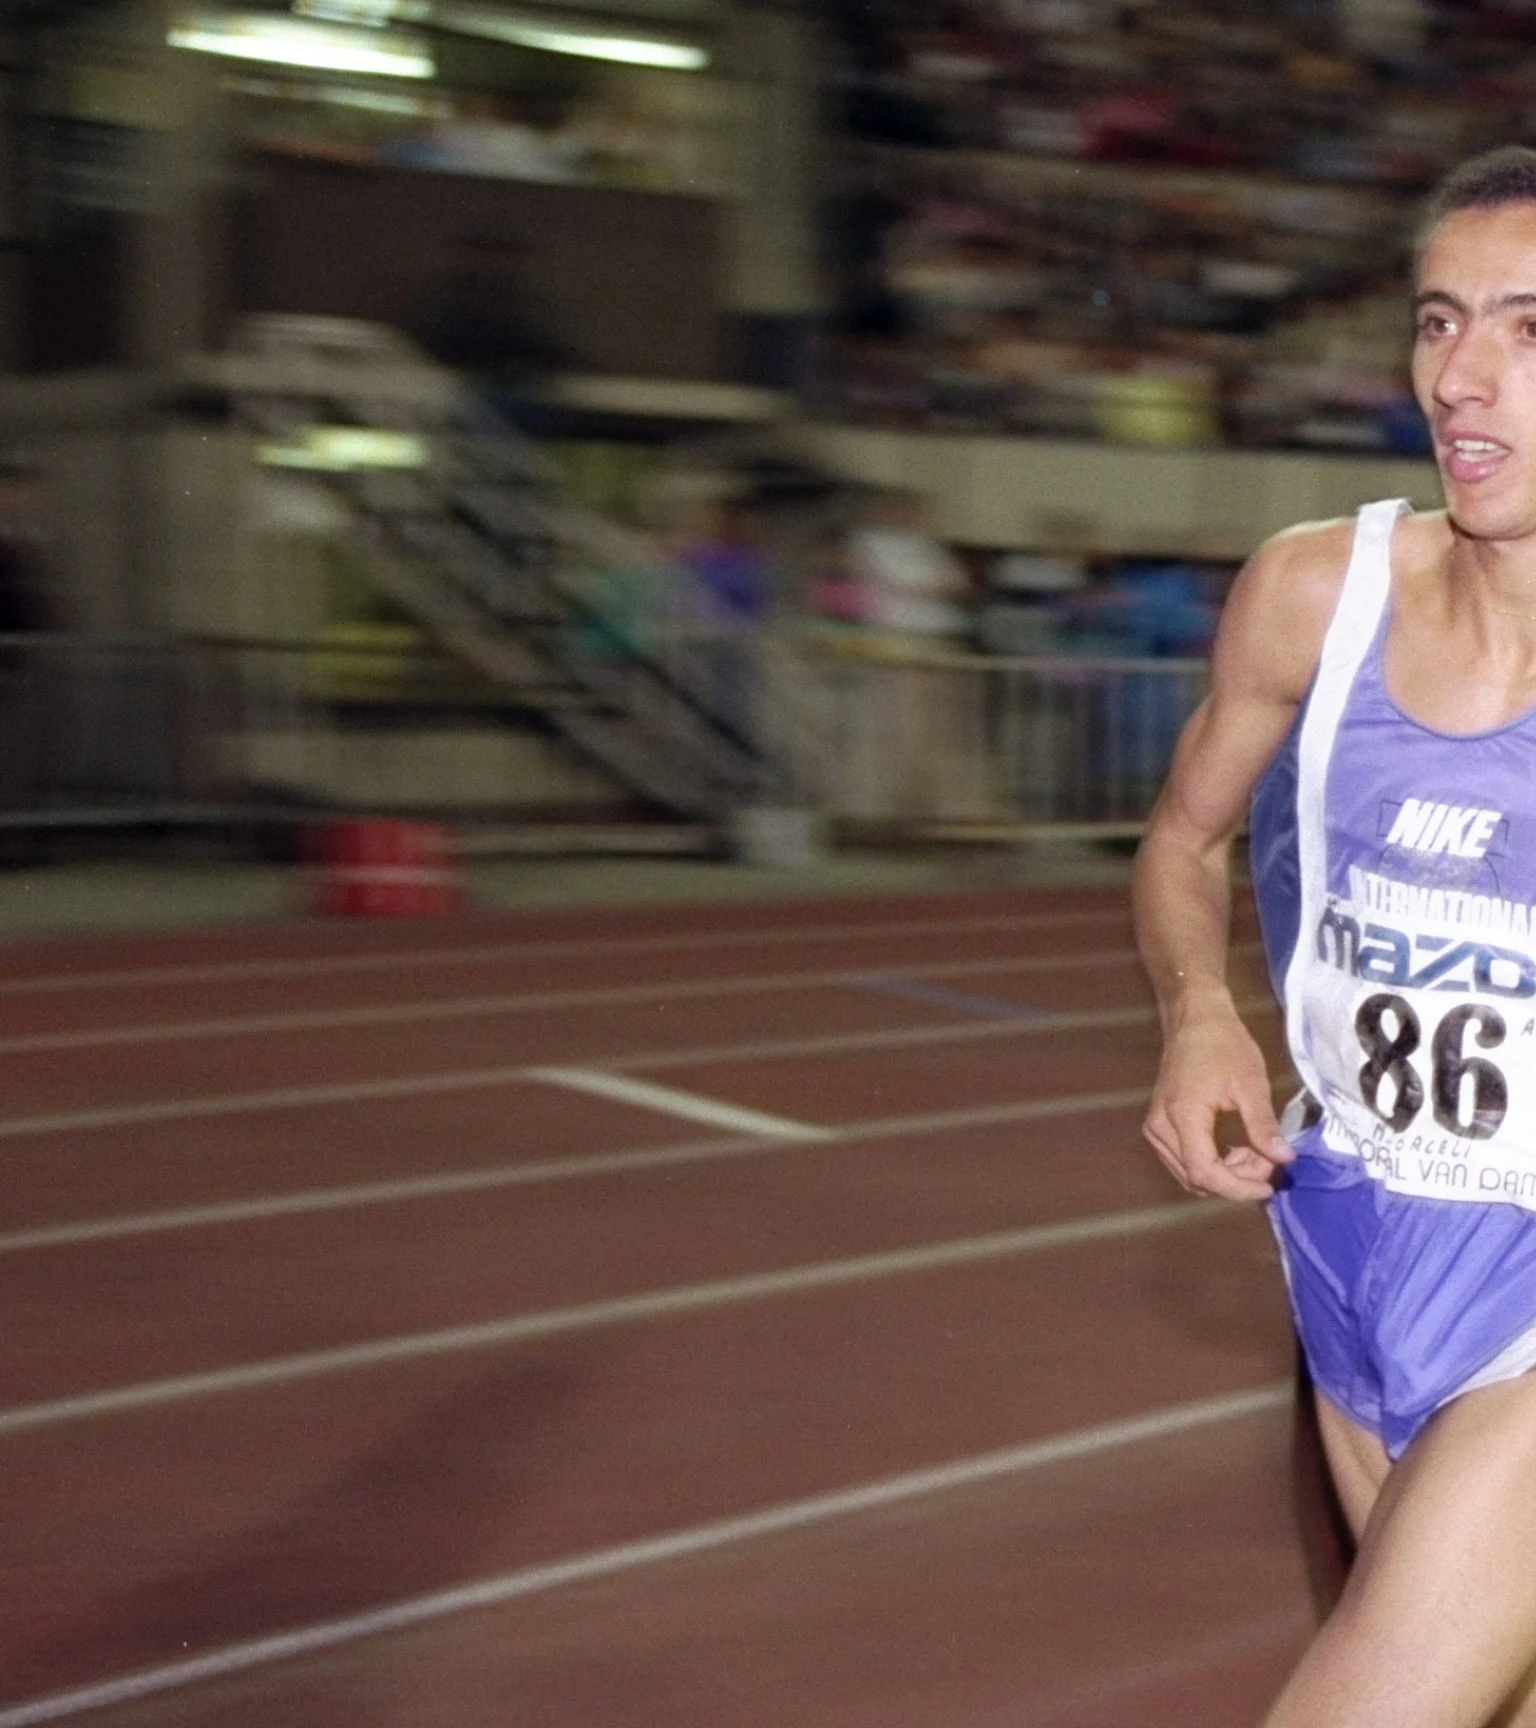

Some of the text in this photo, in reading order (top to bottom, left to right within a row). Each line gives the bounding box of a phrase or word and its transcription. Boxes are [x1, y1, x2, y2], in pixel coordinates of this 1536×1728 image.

[1386, 798, 1503, 858] NIKE
[1354, 992, 1509, 1140] 86
[1418, 1157, 1468, 1189] VAN
